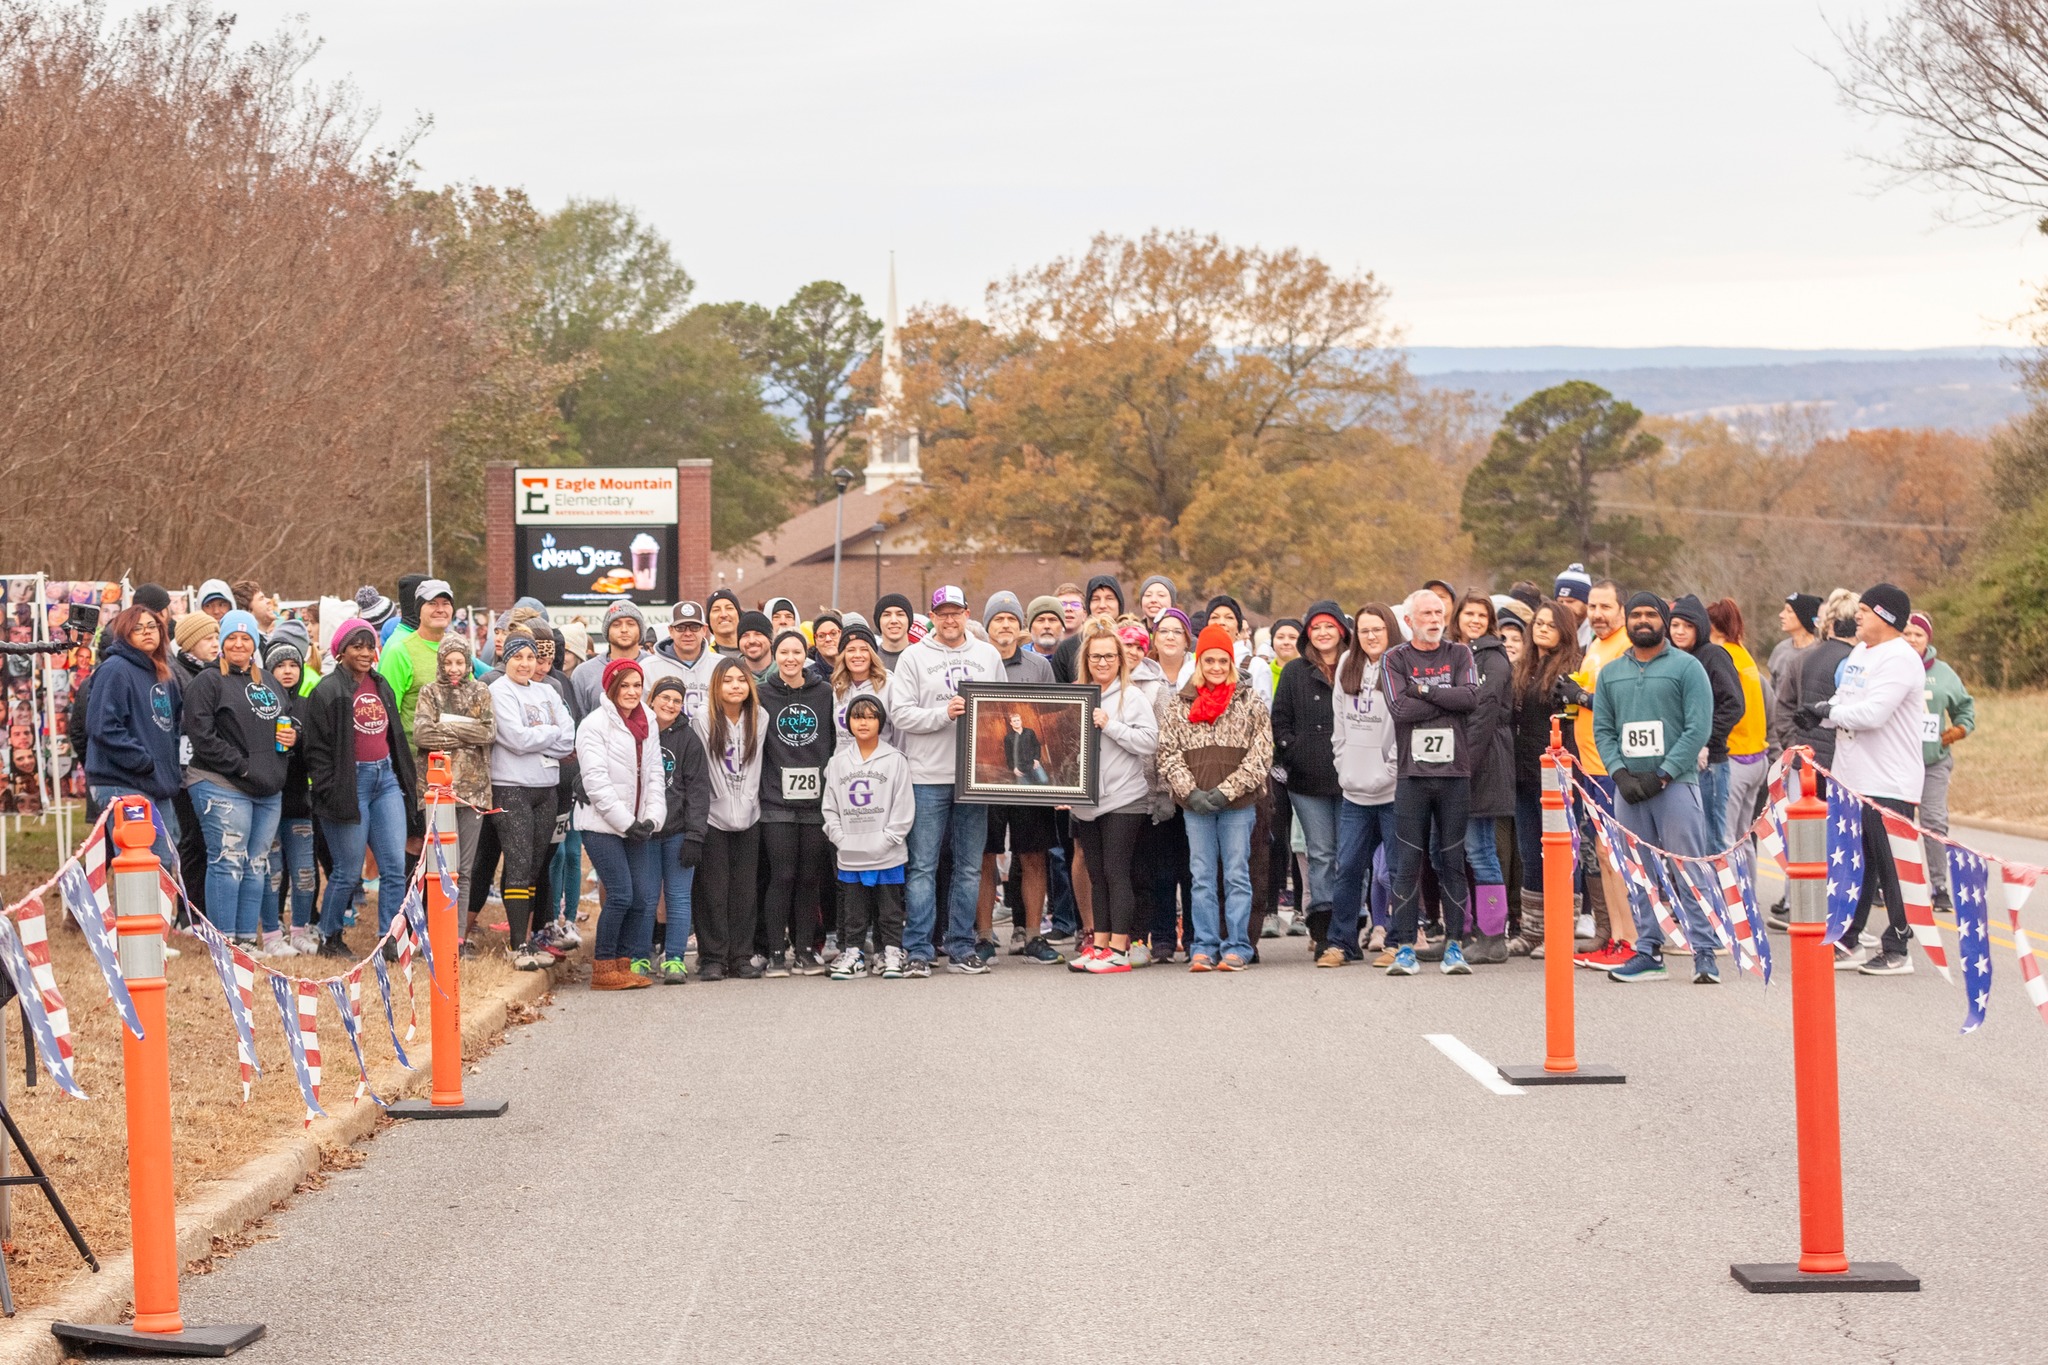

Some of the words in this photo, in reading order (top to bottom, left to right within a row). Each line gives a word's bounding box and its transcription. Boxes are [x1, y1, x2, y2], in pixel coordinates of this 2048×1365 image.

[555, 477, 596, 493] Eagle
[600, 477, 673, 490] Mountain
[555, 493, 634, 509] Elementary
[1424, 736, 1444, 753] 27
[1628, 729, 1657, 747] 851
[789, 774, 816, 791] 728
[849, 780, 873, 807] G
